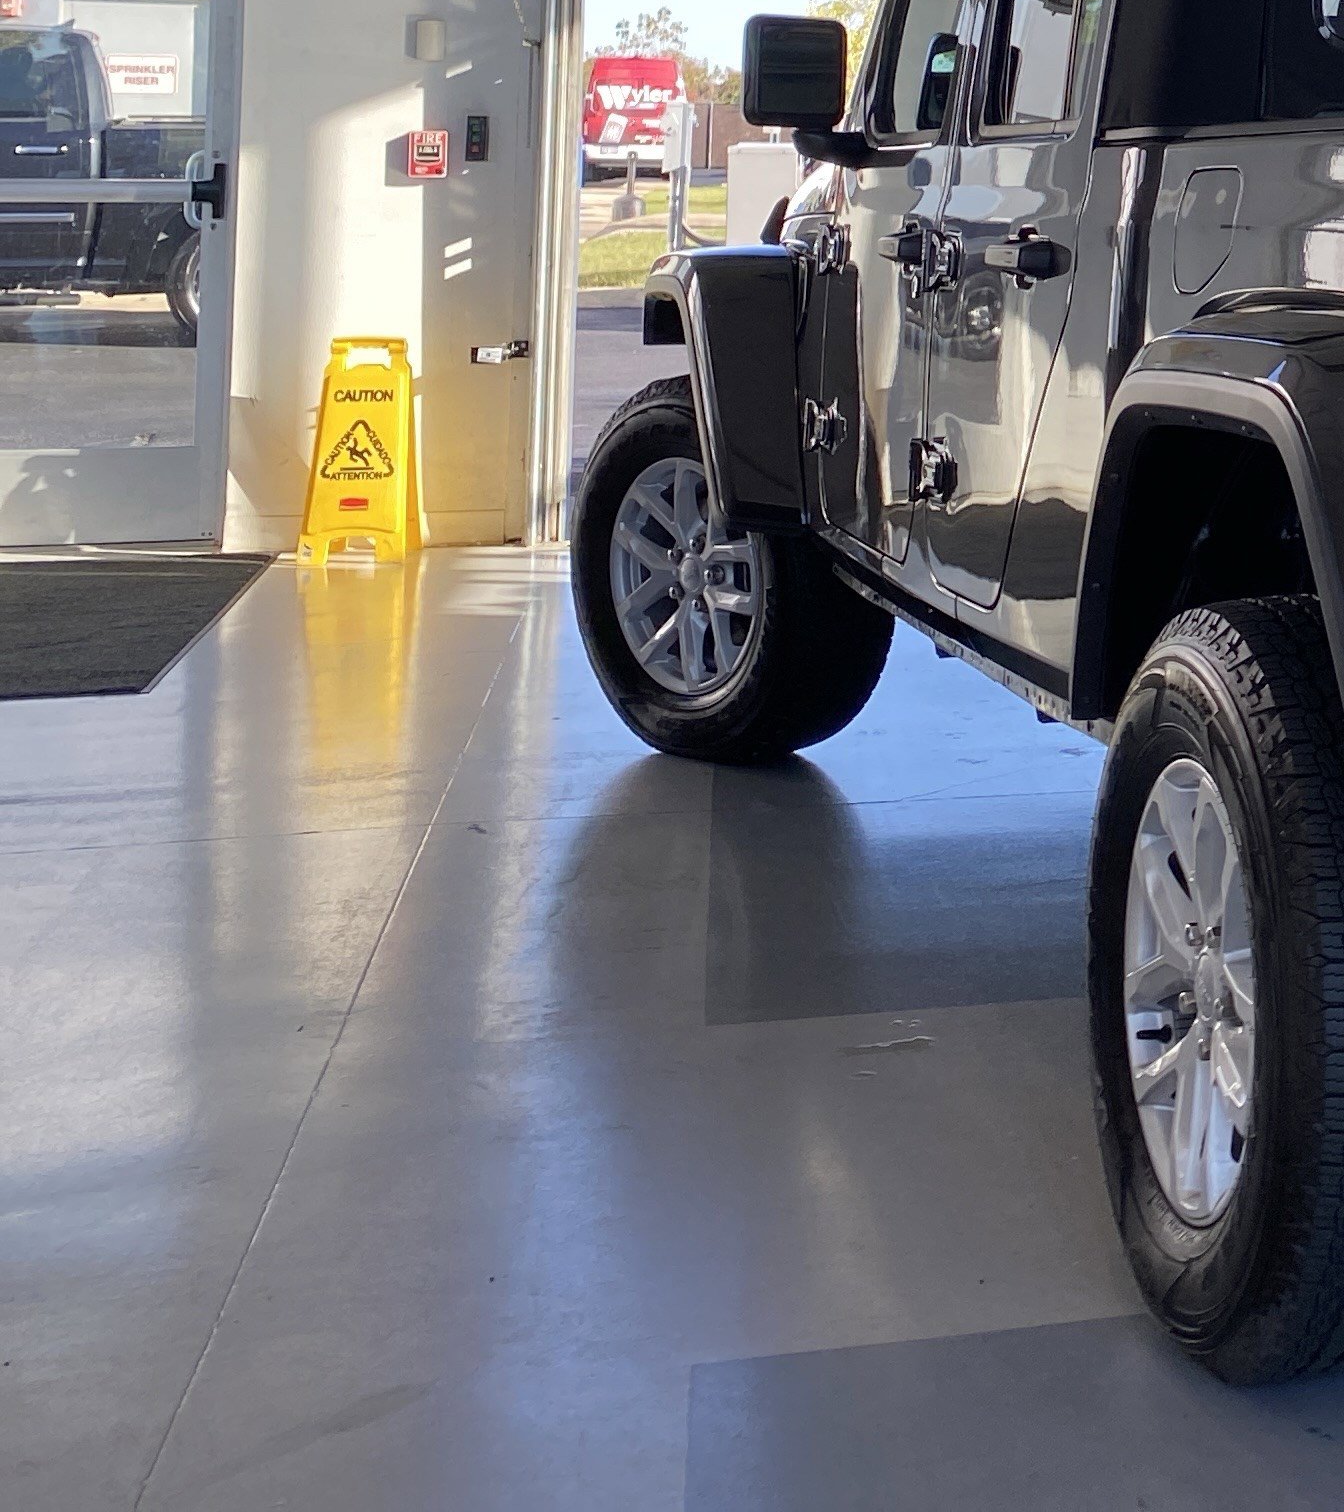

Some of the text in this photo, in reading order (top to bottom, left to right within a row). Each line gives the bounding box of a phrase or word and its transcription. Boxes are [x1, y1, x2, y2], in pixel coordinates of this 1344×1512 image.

[109, 64, 175, 75] SPRINKLER
[124, 76, 159, 85] RISER
[596, 84, 673, 110] Wyler
[414, 132, 443, 145] FIRE
[334, 389, 394, 403] CAUTION
[325, 431, 355, 466] CAUTION
[330, 471, 383, 481] ATTENTION
